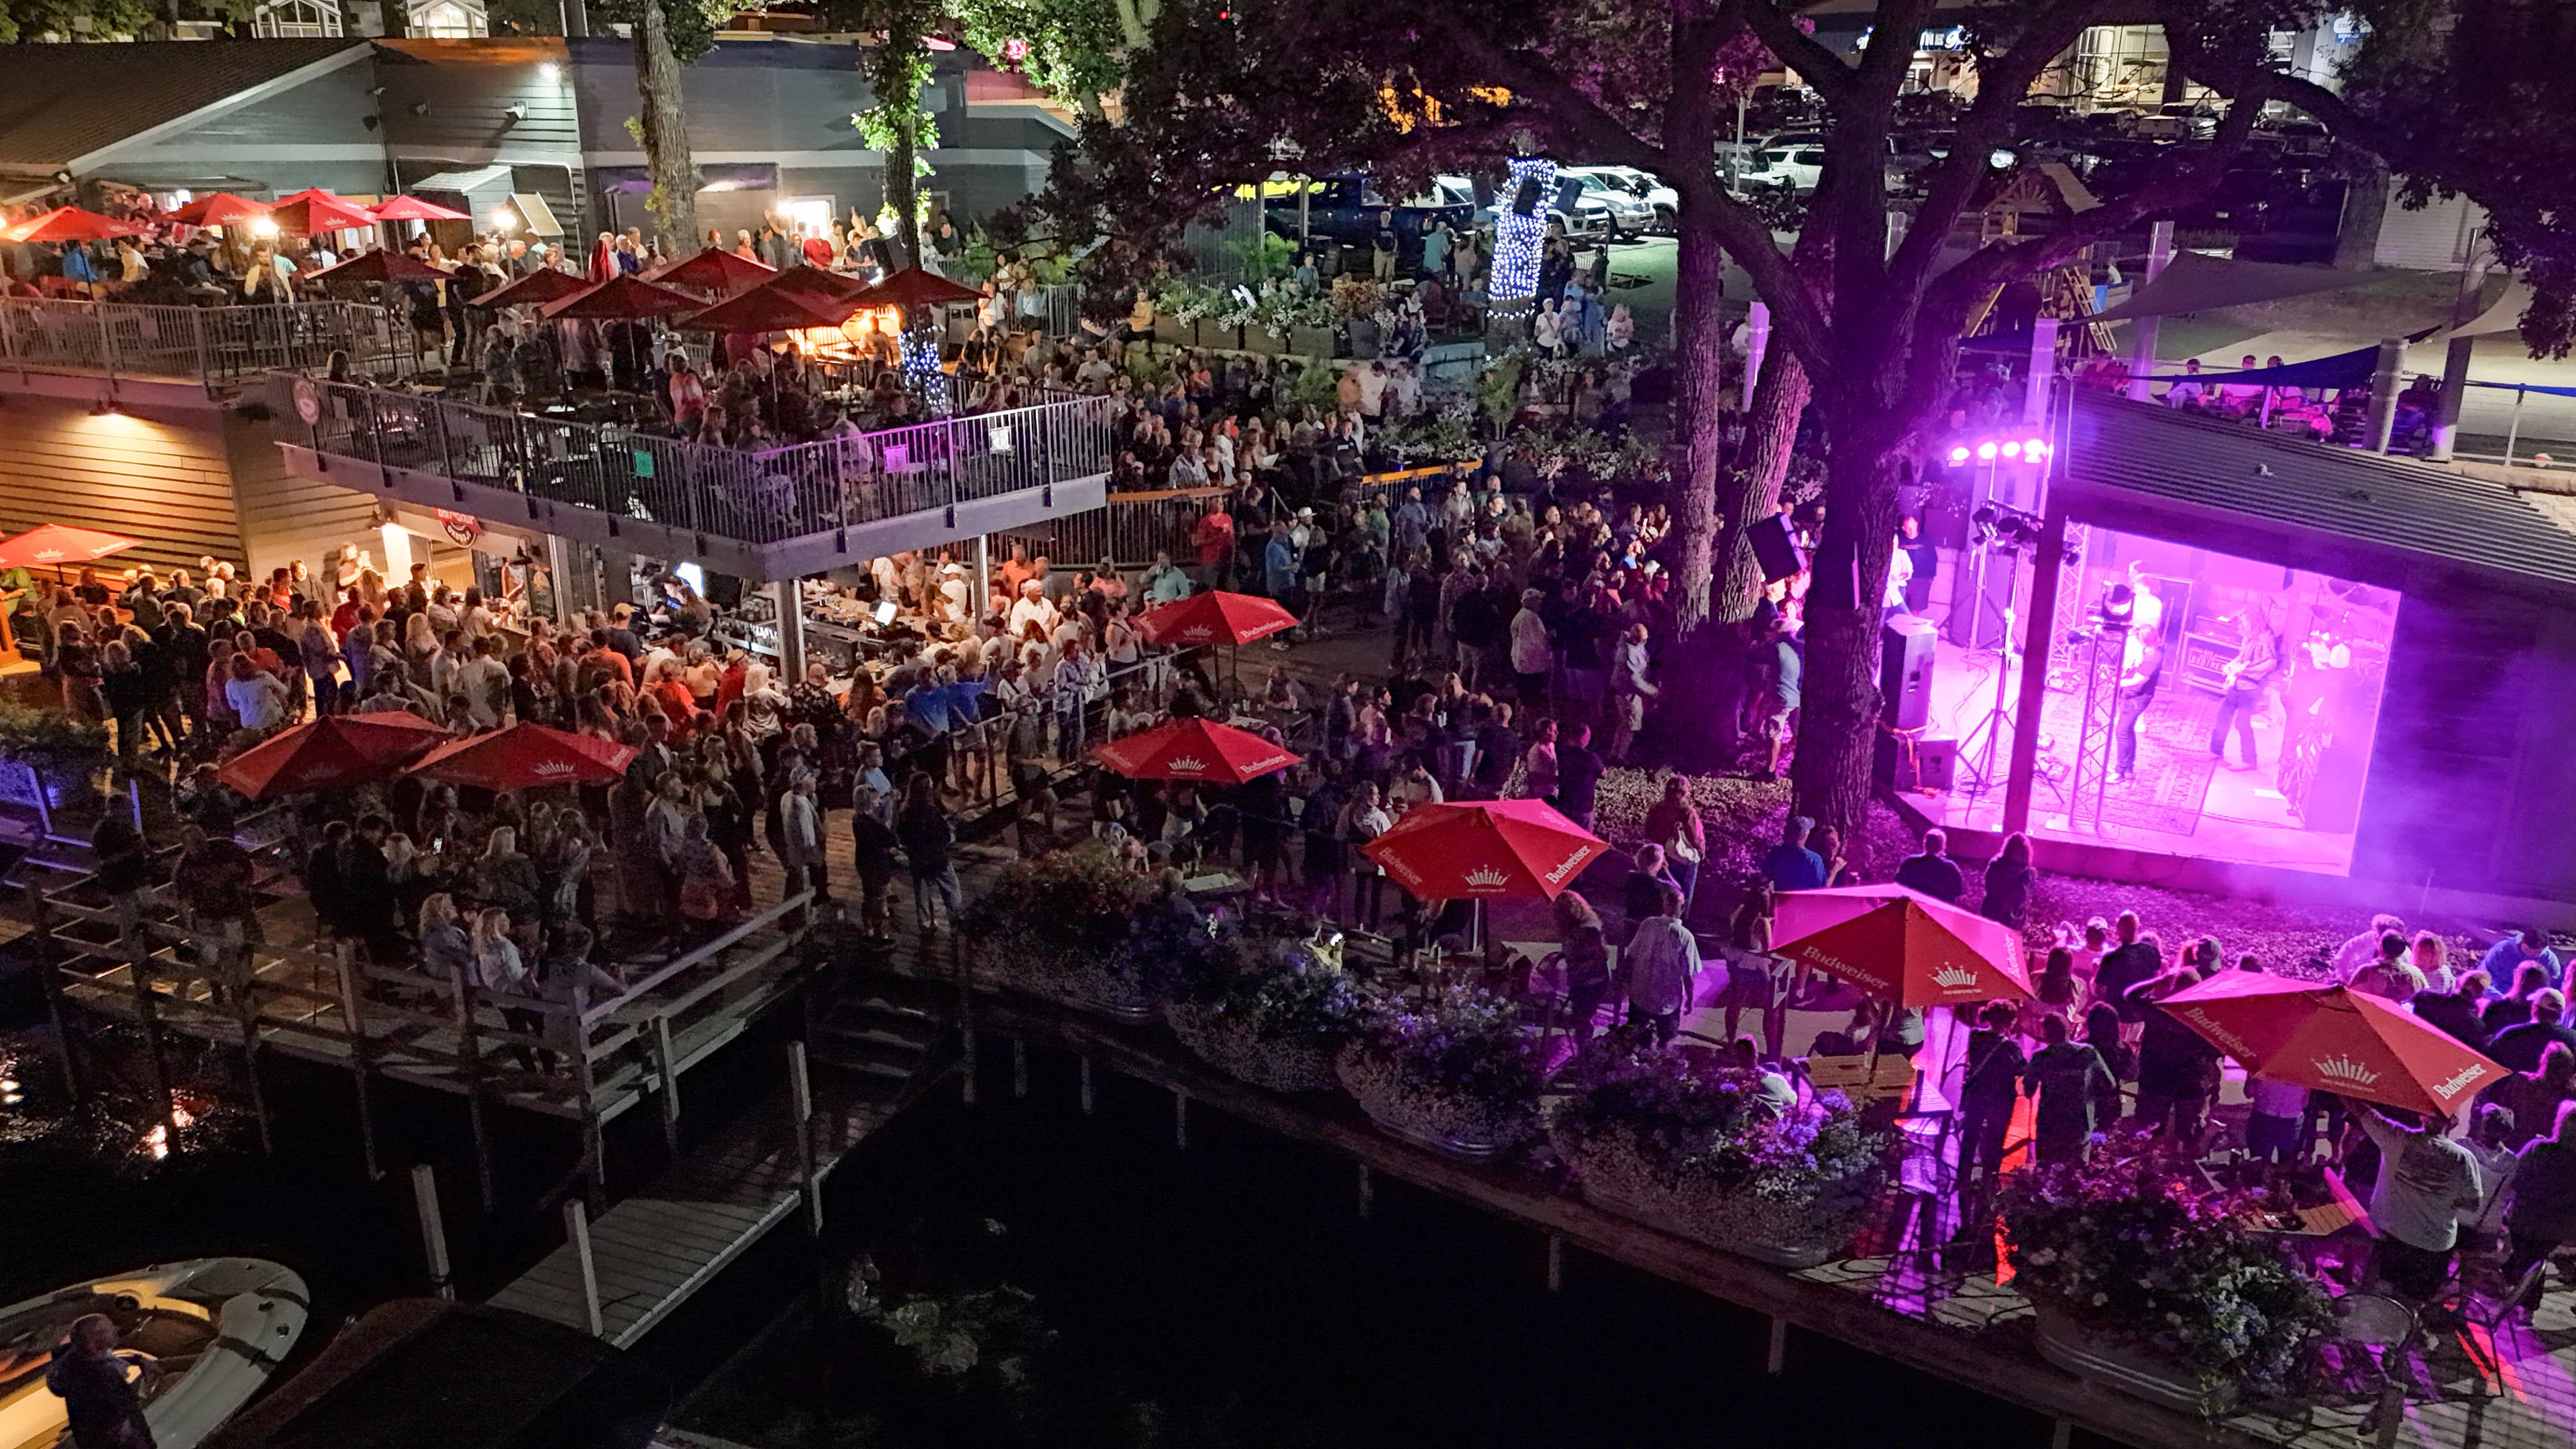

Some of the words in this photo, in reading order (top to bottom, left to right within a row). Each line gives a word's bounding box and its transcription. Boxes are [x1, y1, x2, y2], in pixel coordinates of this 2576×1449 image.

[1545, 845, 1592, 885] Budweiser
[1802, 946, 1890, 989] Budweiser
[2184, 1007, 2257, 1058] Budweiser
[2432, 1063, 2486, 1101] Budweiser
